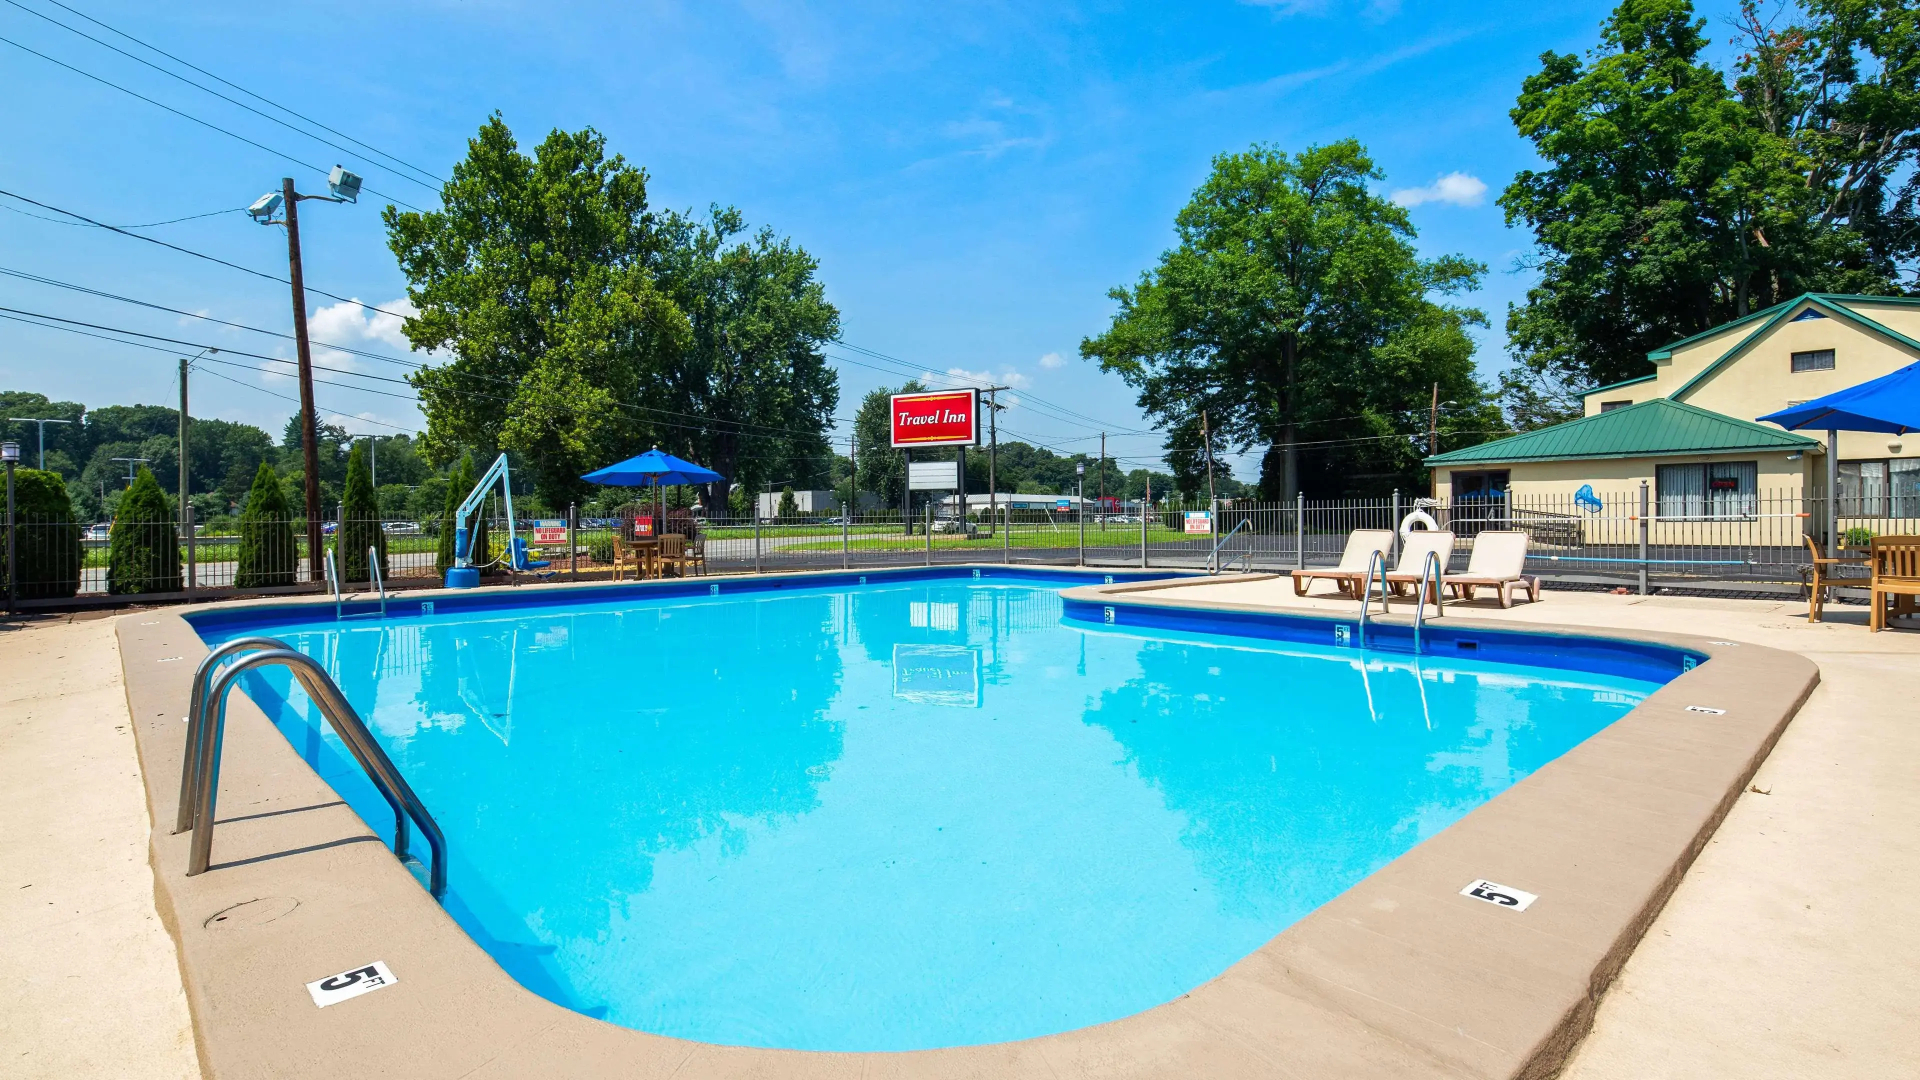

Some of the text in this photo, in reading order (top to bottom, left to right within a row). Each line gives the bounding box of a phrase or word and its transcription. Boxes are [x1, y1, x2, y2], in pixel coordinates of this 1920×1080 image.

[898, 409, 966, 426] Travel Inn
[1336, 626, 1344, 638] 5
[1469, 887, 1519, 906] 5
[320, 965, 379, 991] 5
